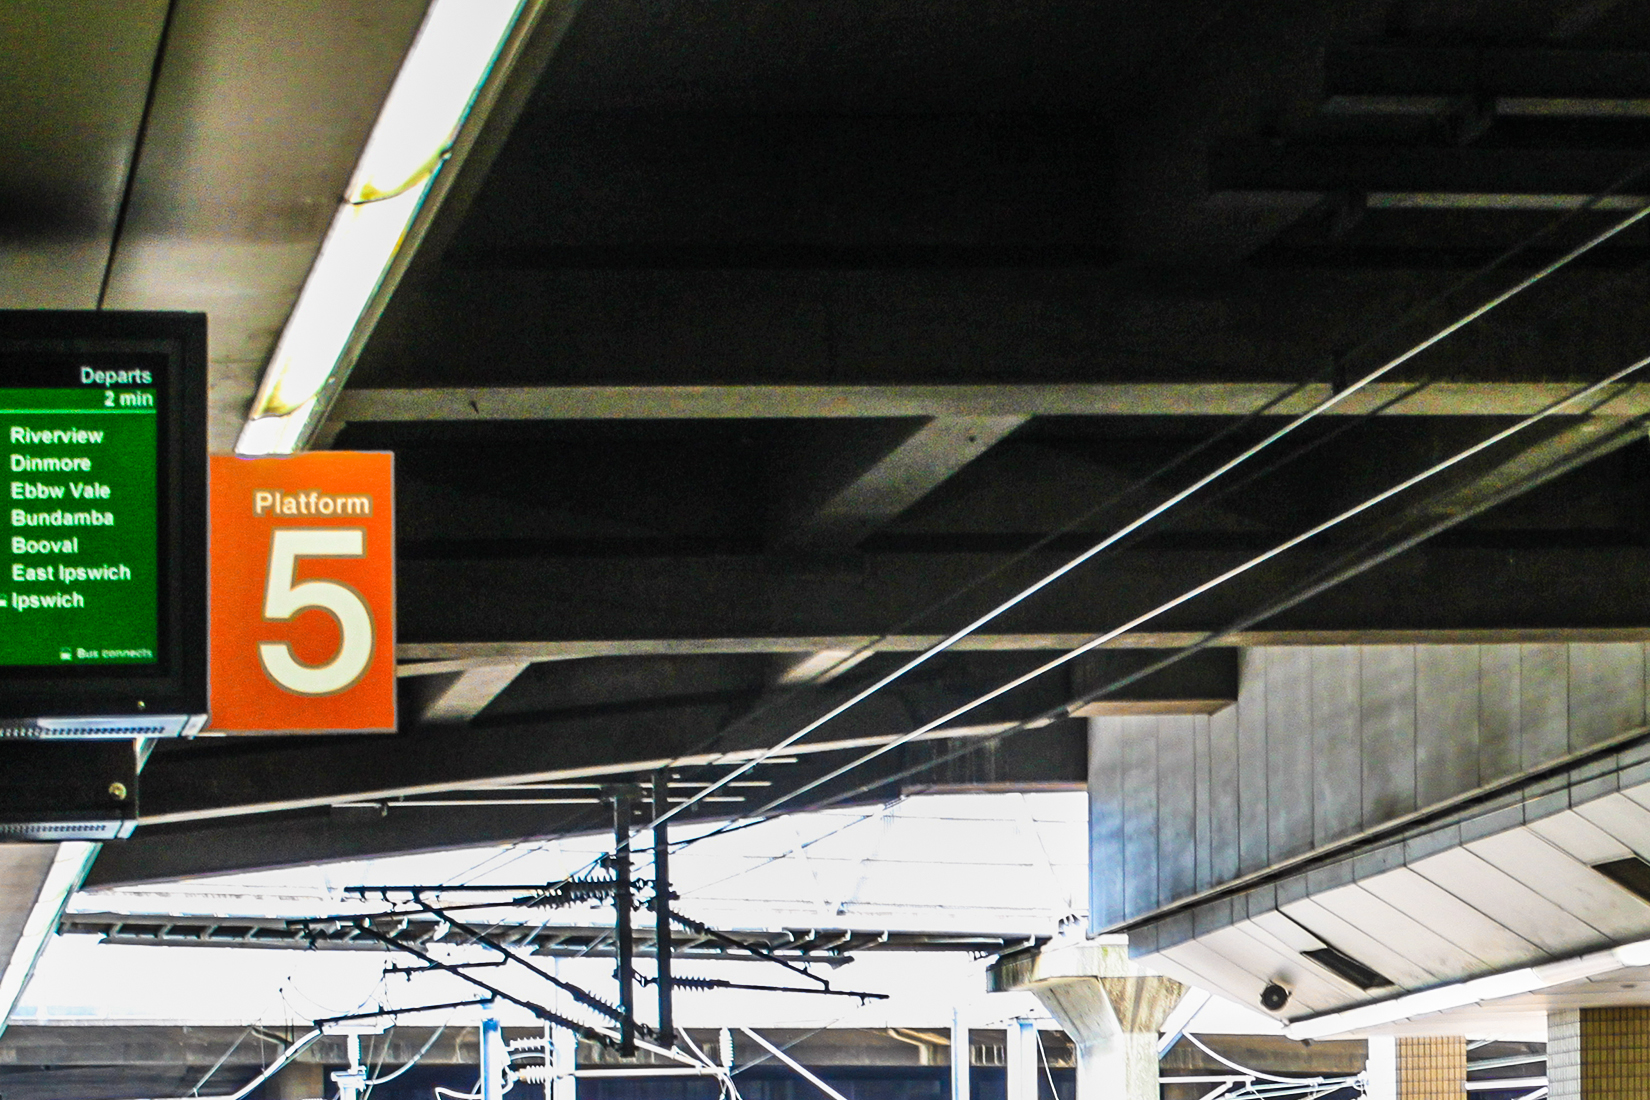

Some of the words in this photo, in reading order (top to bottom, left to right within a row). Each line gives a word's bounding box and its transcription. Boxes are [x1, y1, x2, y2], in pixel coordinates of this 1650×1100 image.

[80, 365, 153, 387] Departs
[103, 390, 116, 407] 2
[118, 390, 154, 407] min
[10, 425, 105, 444] Riverview
[10, 453, 92, 472] Dinmore
[10, 481, 66, 500] Ebbw
[69, 481, 112, 499] Vale
[254, 491, 371, 515] Platform
[11, 508, 115, 527] Bundamba
[11, 536, 79, 555] Booval
[11, 563, 55, 582] East
[58, 563, 132, 585] Ipswich
[11, 591, 85, 612] Ipswich
[259, 529, 373, 695] 5
